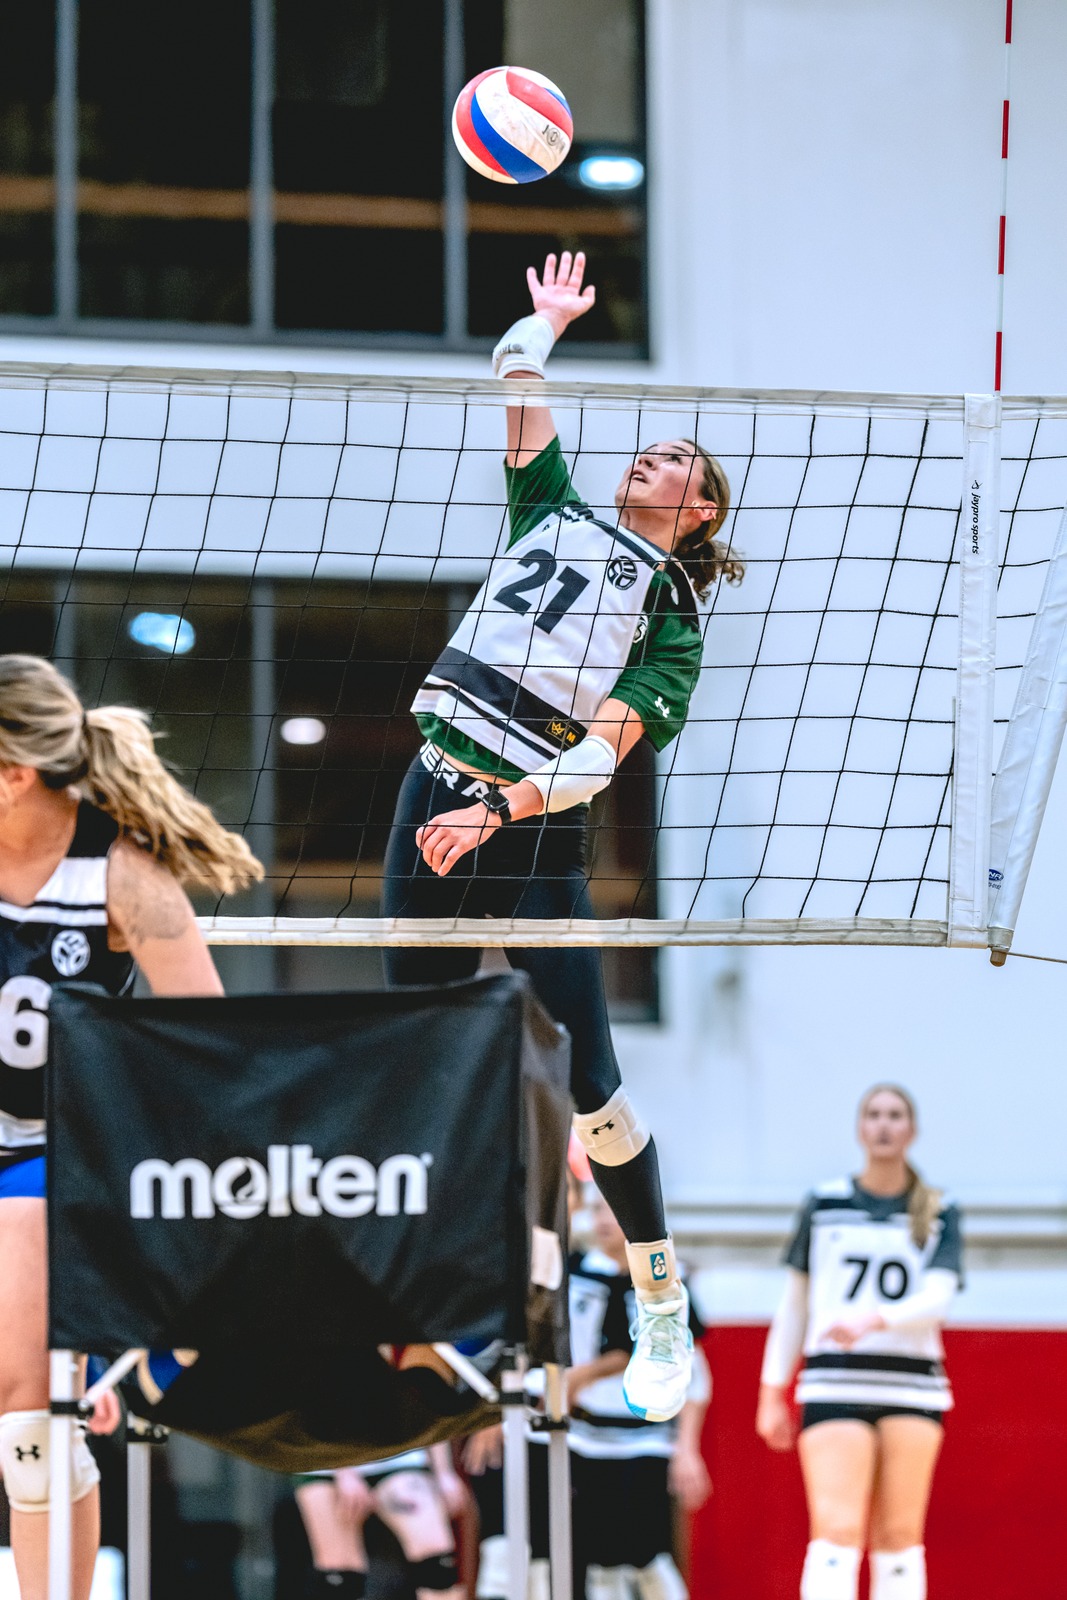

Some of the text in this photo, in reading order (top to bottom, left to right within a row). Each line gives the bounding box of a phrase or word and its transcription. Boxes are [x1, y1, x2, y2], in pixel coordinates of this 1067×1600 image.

[971, 492, 981, 554] jaypro sports
[493, 549, 590, 635] 21
[0, 975, 50, 1070] 6
[130, 1144, 429, 1219] molten
[843, 1257, 909, 1301] 70
